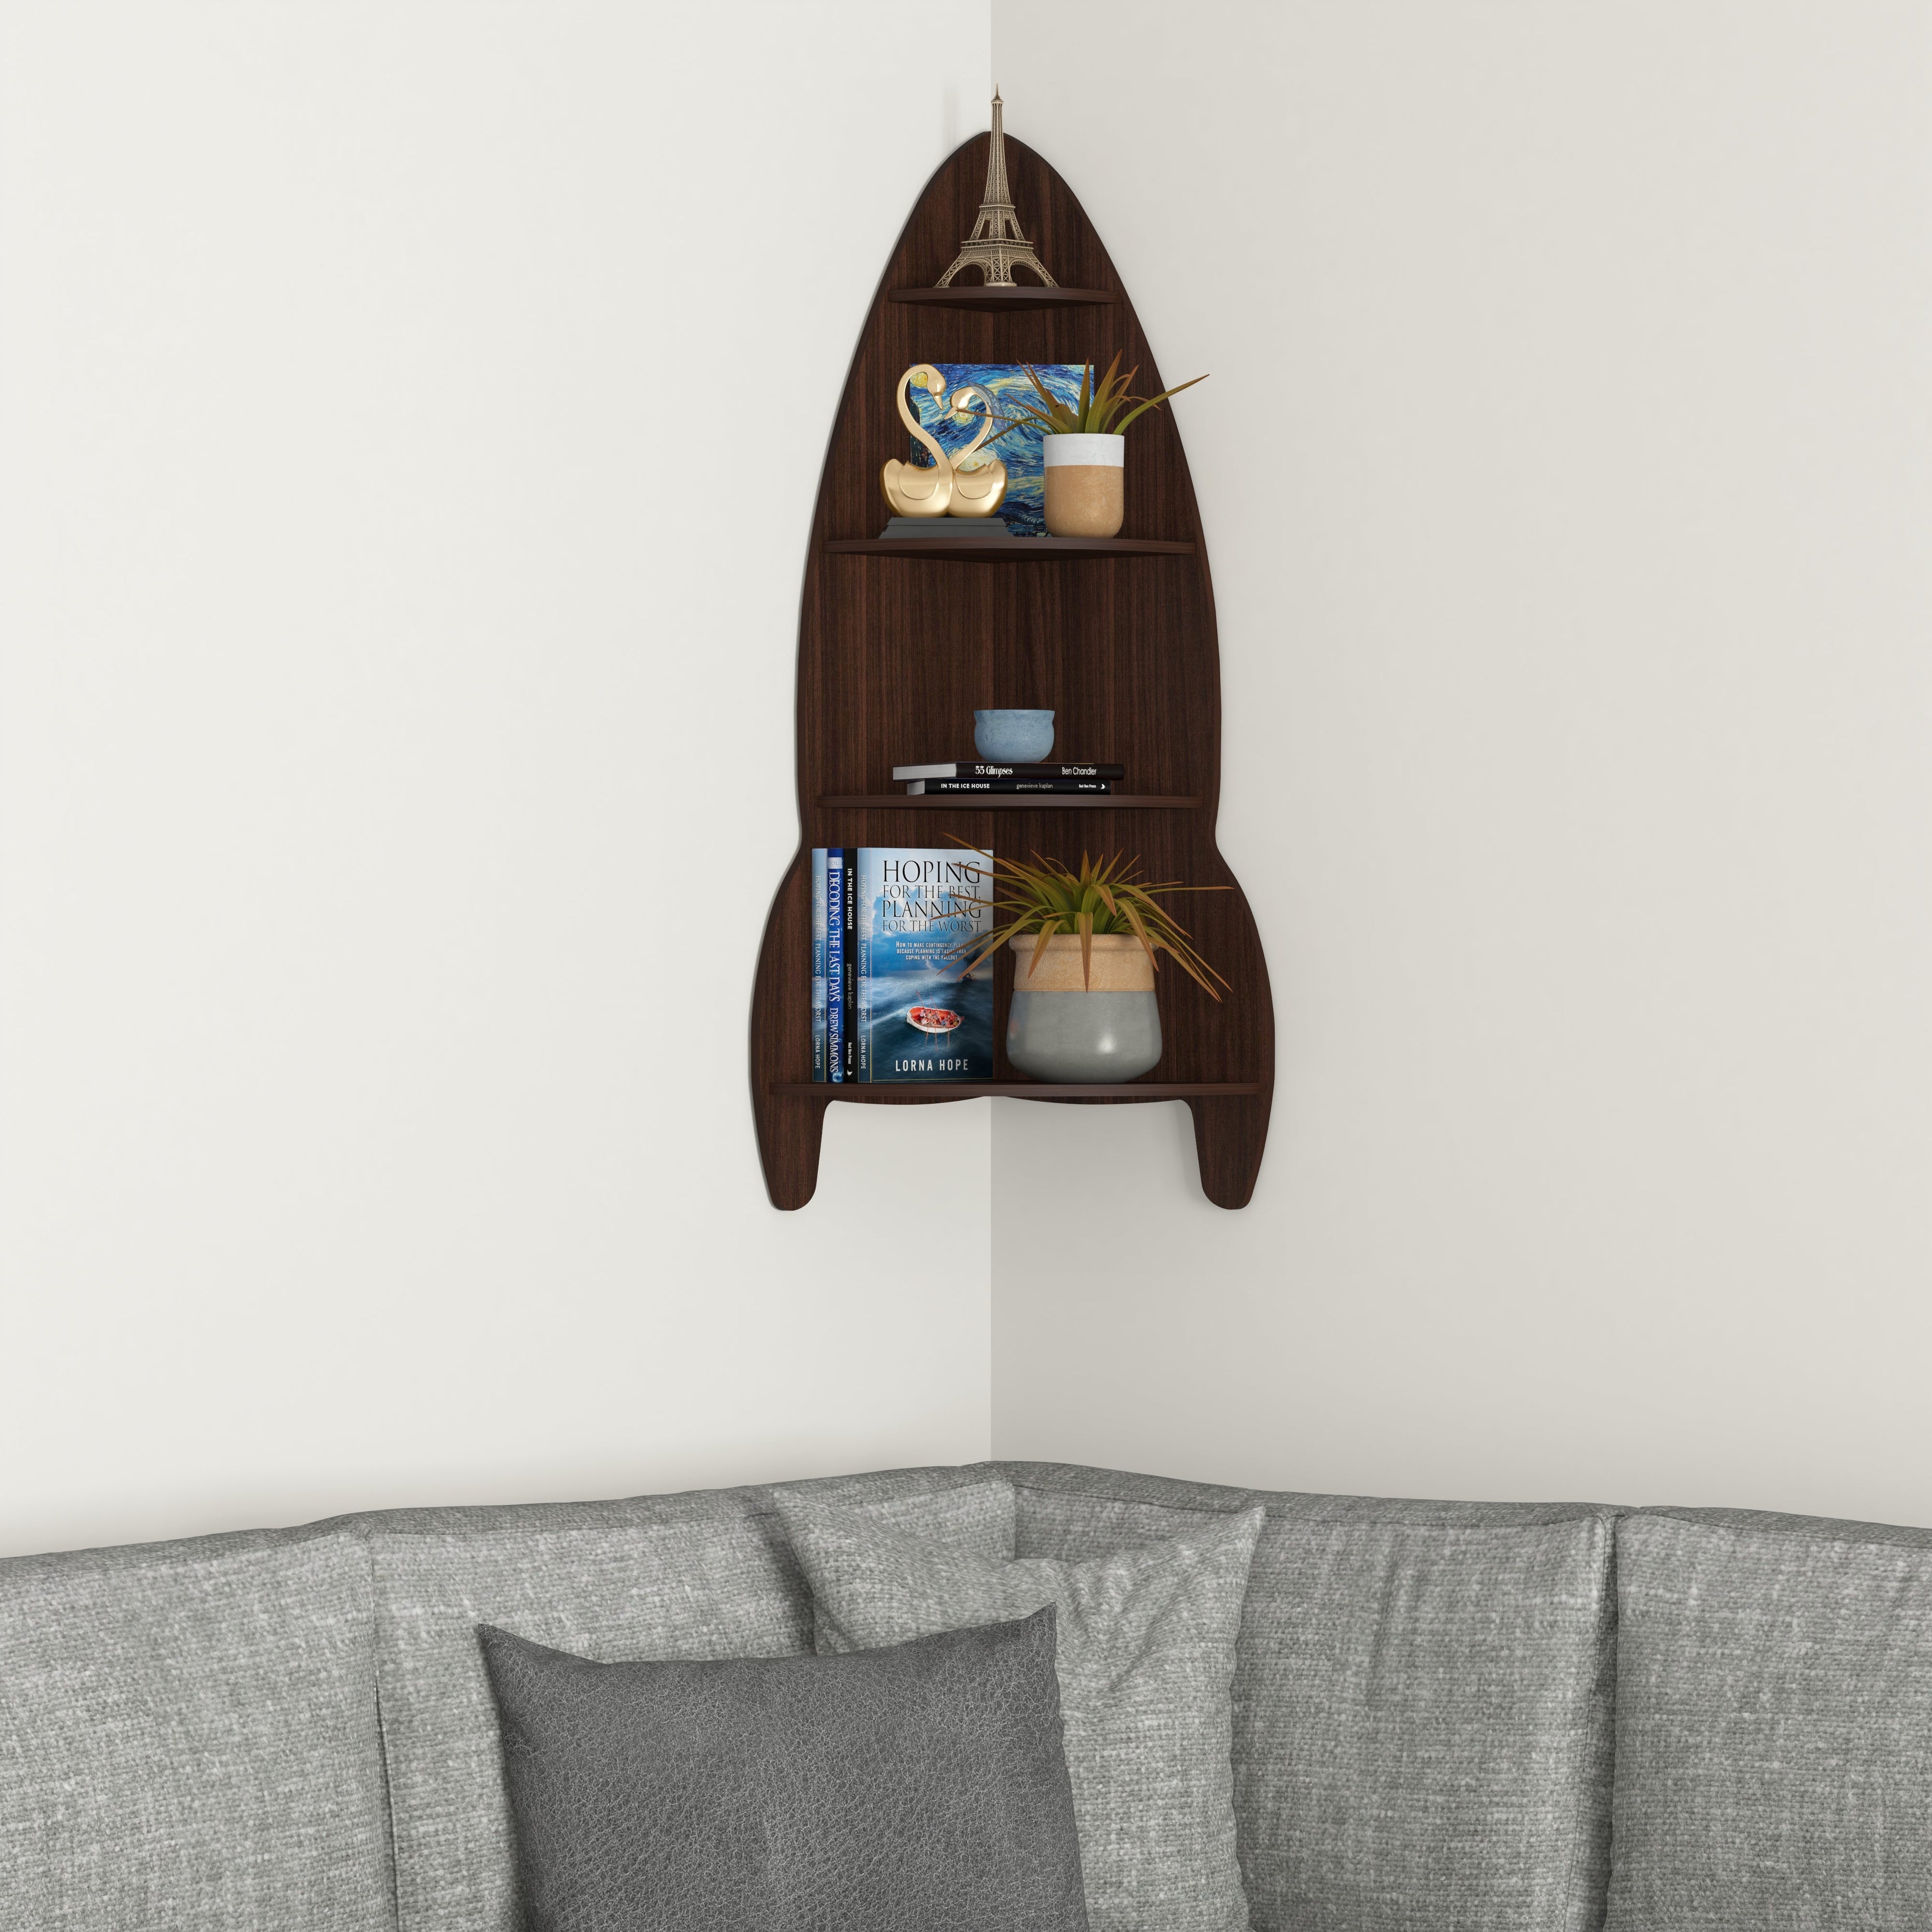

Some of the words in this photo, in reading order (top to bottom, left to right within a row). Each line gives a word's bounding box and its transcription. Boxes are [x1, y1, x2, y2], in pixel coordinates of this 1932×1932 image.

[975, 765, 985, 775] 55
[986, 765, 1013, 778] Glimpses
[1062, 767, 1072, 775] Ben
[1073, 767, 1097, 775] Chandler
[883, 860, 981, 883] HOPING
[829, 872, 840, 926] DECODING
[883, 884, 911, 899] FOR
[915, 885, 943, 899] THE
[882, 900, 982, 918] PLANNING
[883, 920, 907, 932] FOR
[910, 920, 934, 932] THE
[938, 921, 982, 932] WORST
[829, 928, 840, 948] THE
[829, 951, 840, 975] LAST
[829, 977, 840, 1002] DAYS
[830, 1008, 839, 1032] DREW
[830, 1033, 839, 1072] SIMMONS
[896, 1060, 933, 1072] LORNA
[939, 1059, 968, 1071] HOPE
